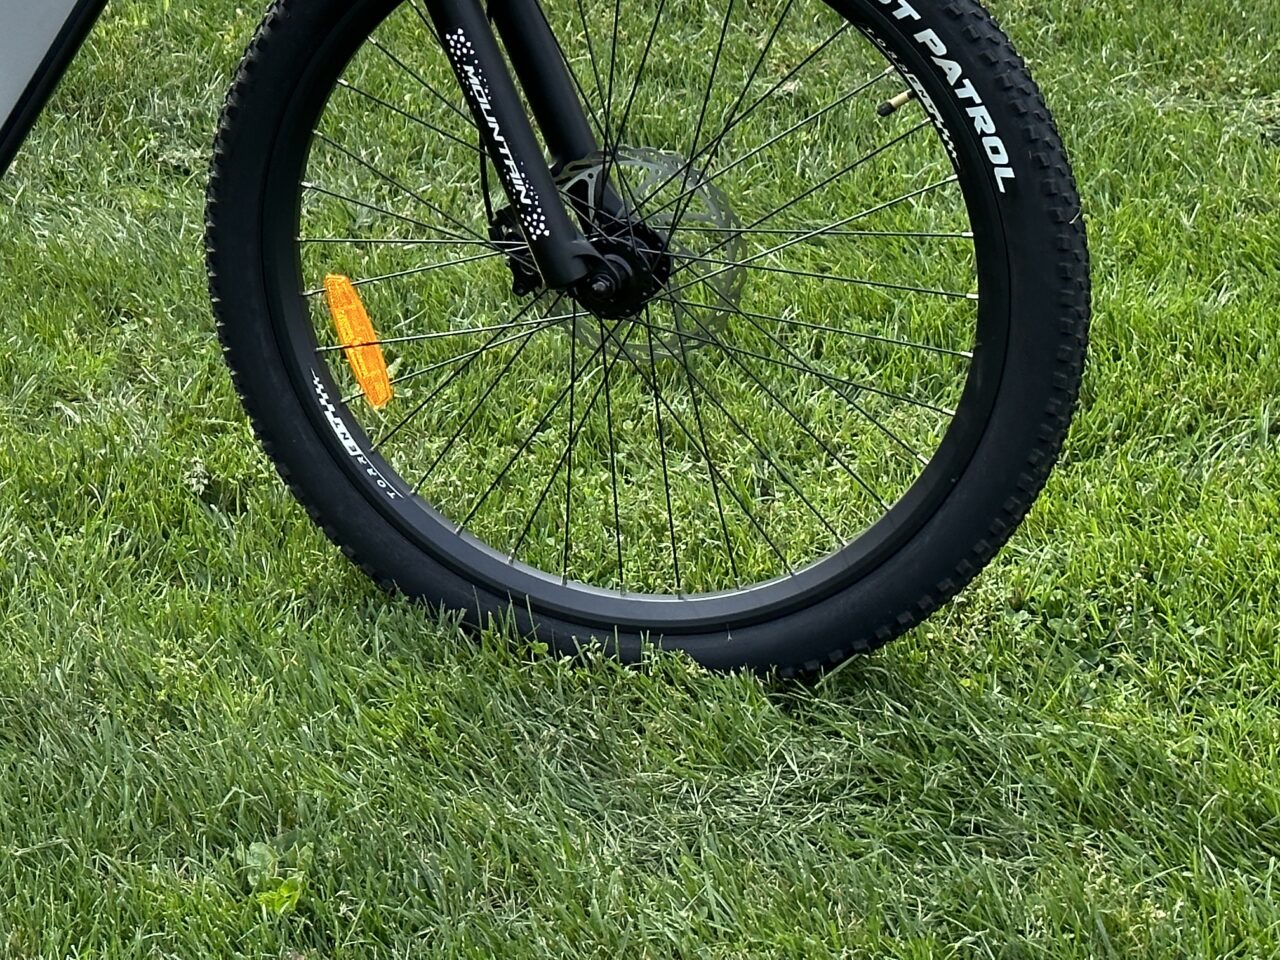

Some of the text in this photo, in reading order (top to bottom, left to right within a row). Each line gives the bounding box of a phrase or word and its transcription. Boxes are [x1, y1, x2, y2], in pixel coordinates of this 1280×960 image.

[462, 64, 532, 205] MOUNTAIN
[913, 27, 1016, 194] PATROL
[330, 418, 396, 500] TORRENT
